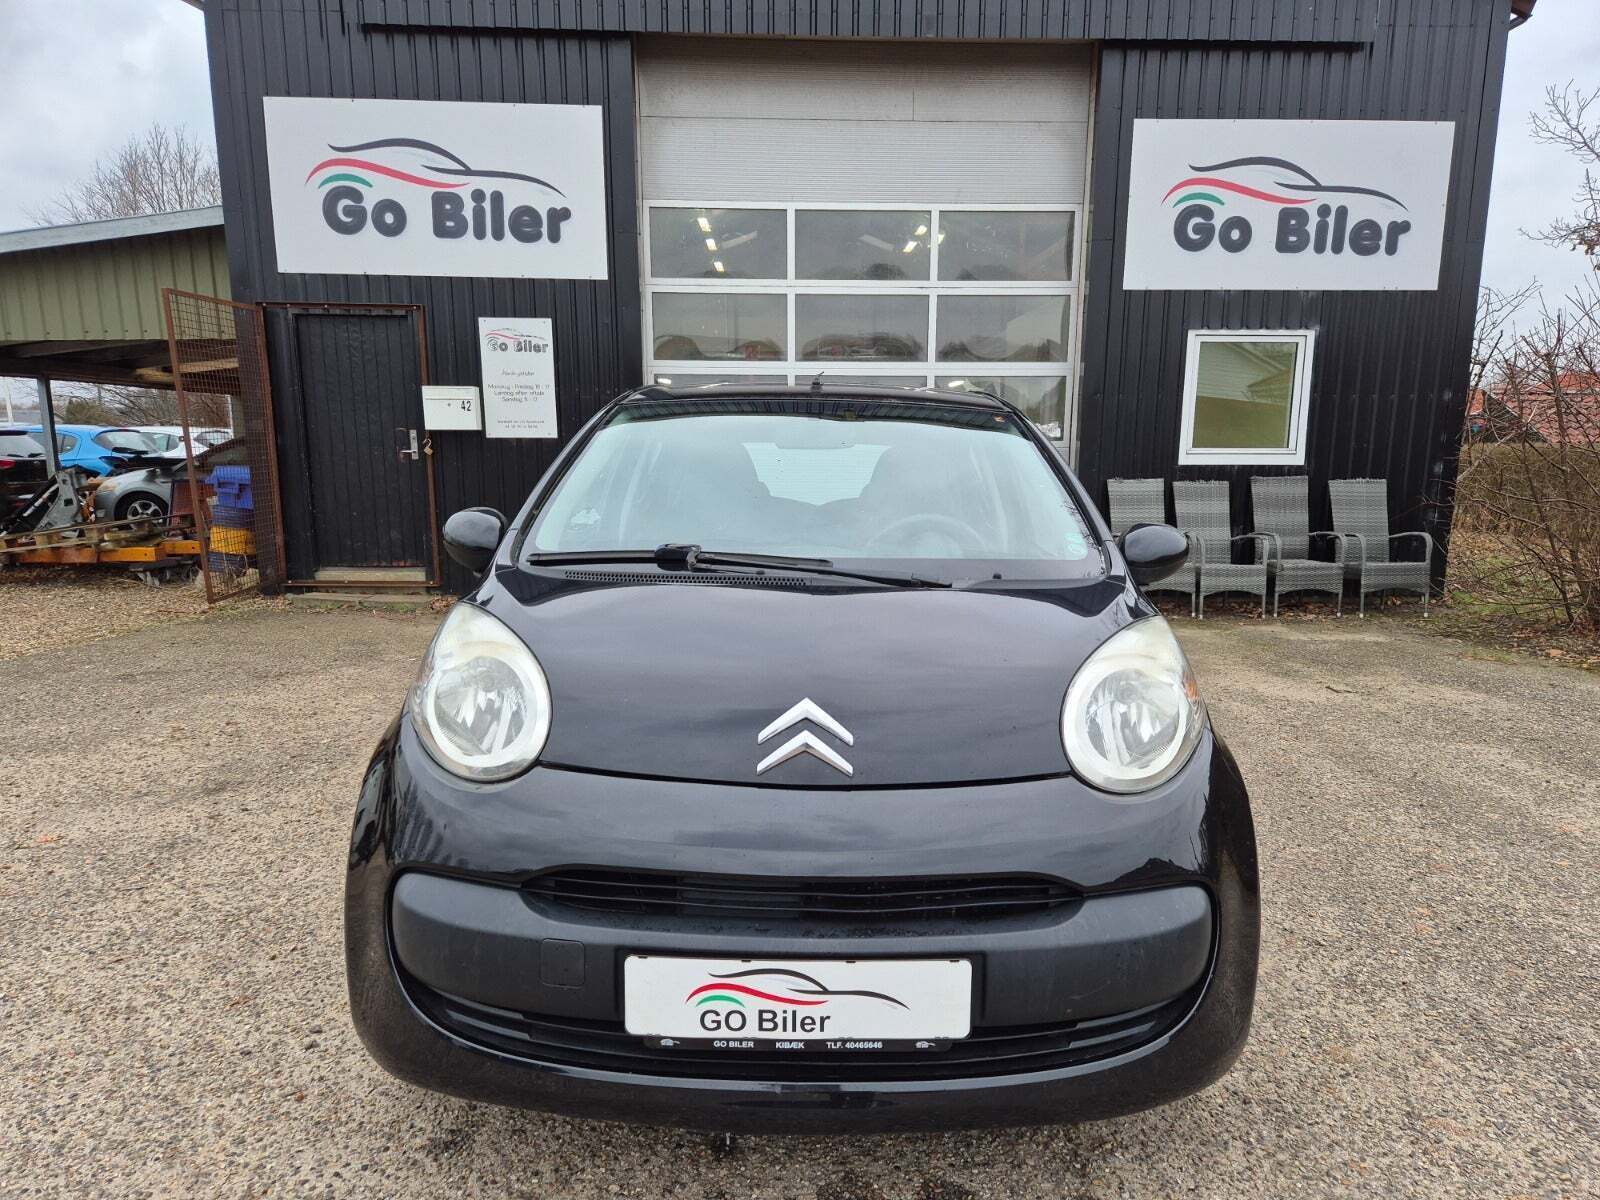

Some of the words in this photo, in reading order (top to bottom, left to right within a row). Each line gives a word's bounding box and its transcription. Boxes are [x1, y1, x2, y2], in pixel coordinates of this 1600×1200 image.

[322, 185, 407, 237] Go
[431, 188, 572, 244] Biler
[1173, 203, 1252, 254] Go
[1275, 204, 1411, 256] Biler
[513, 339, 549, 353] Biler
[460, 400, 472, 411] 42
[699, 1010, 747, 1032] GO
[758, 1010, 831, 1033] Biler
[713, 1040, 727, 1048] GO
[826, 1041, 843, 1049] TLF.
